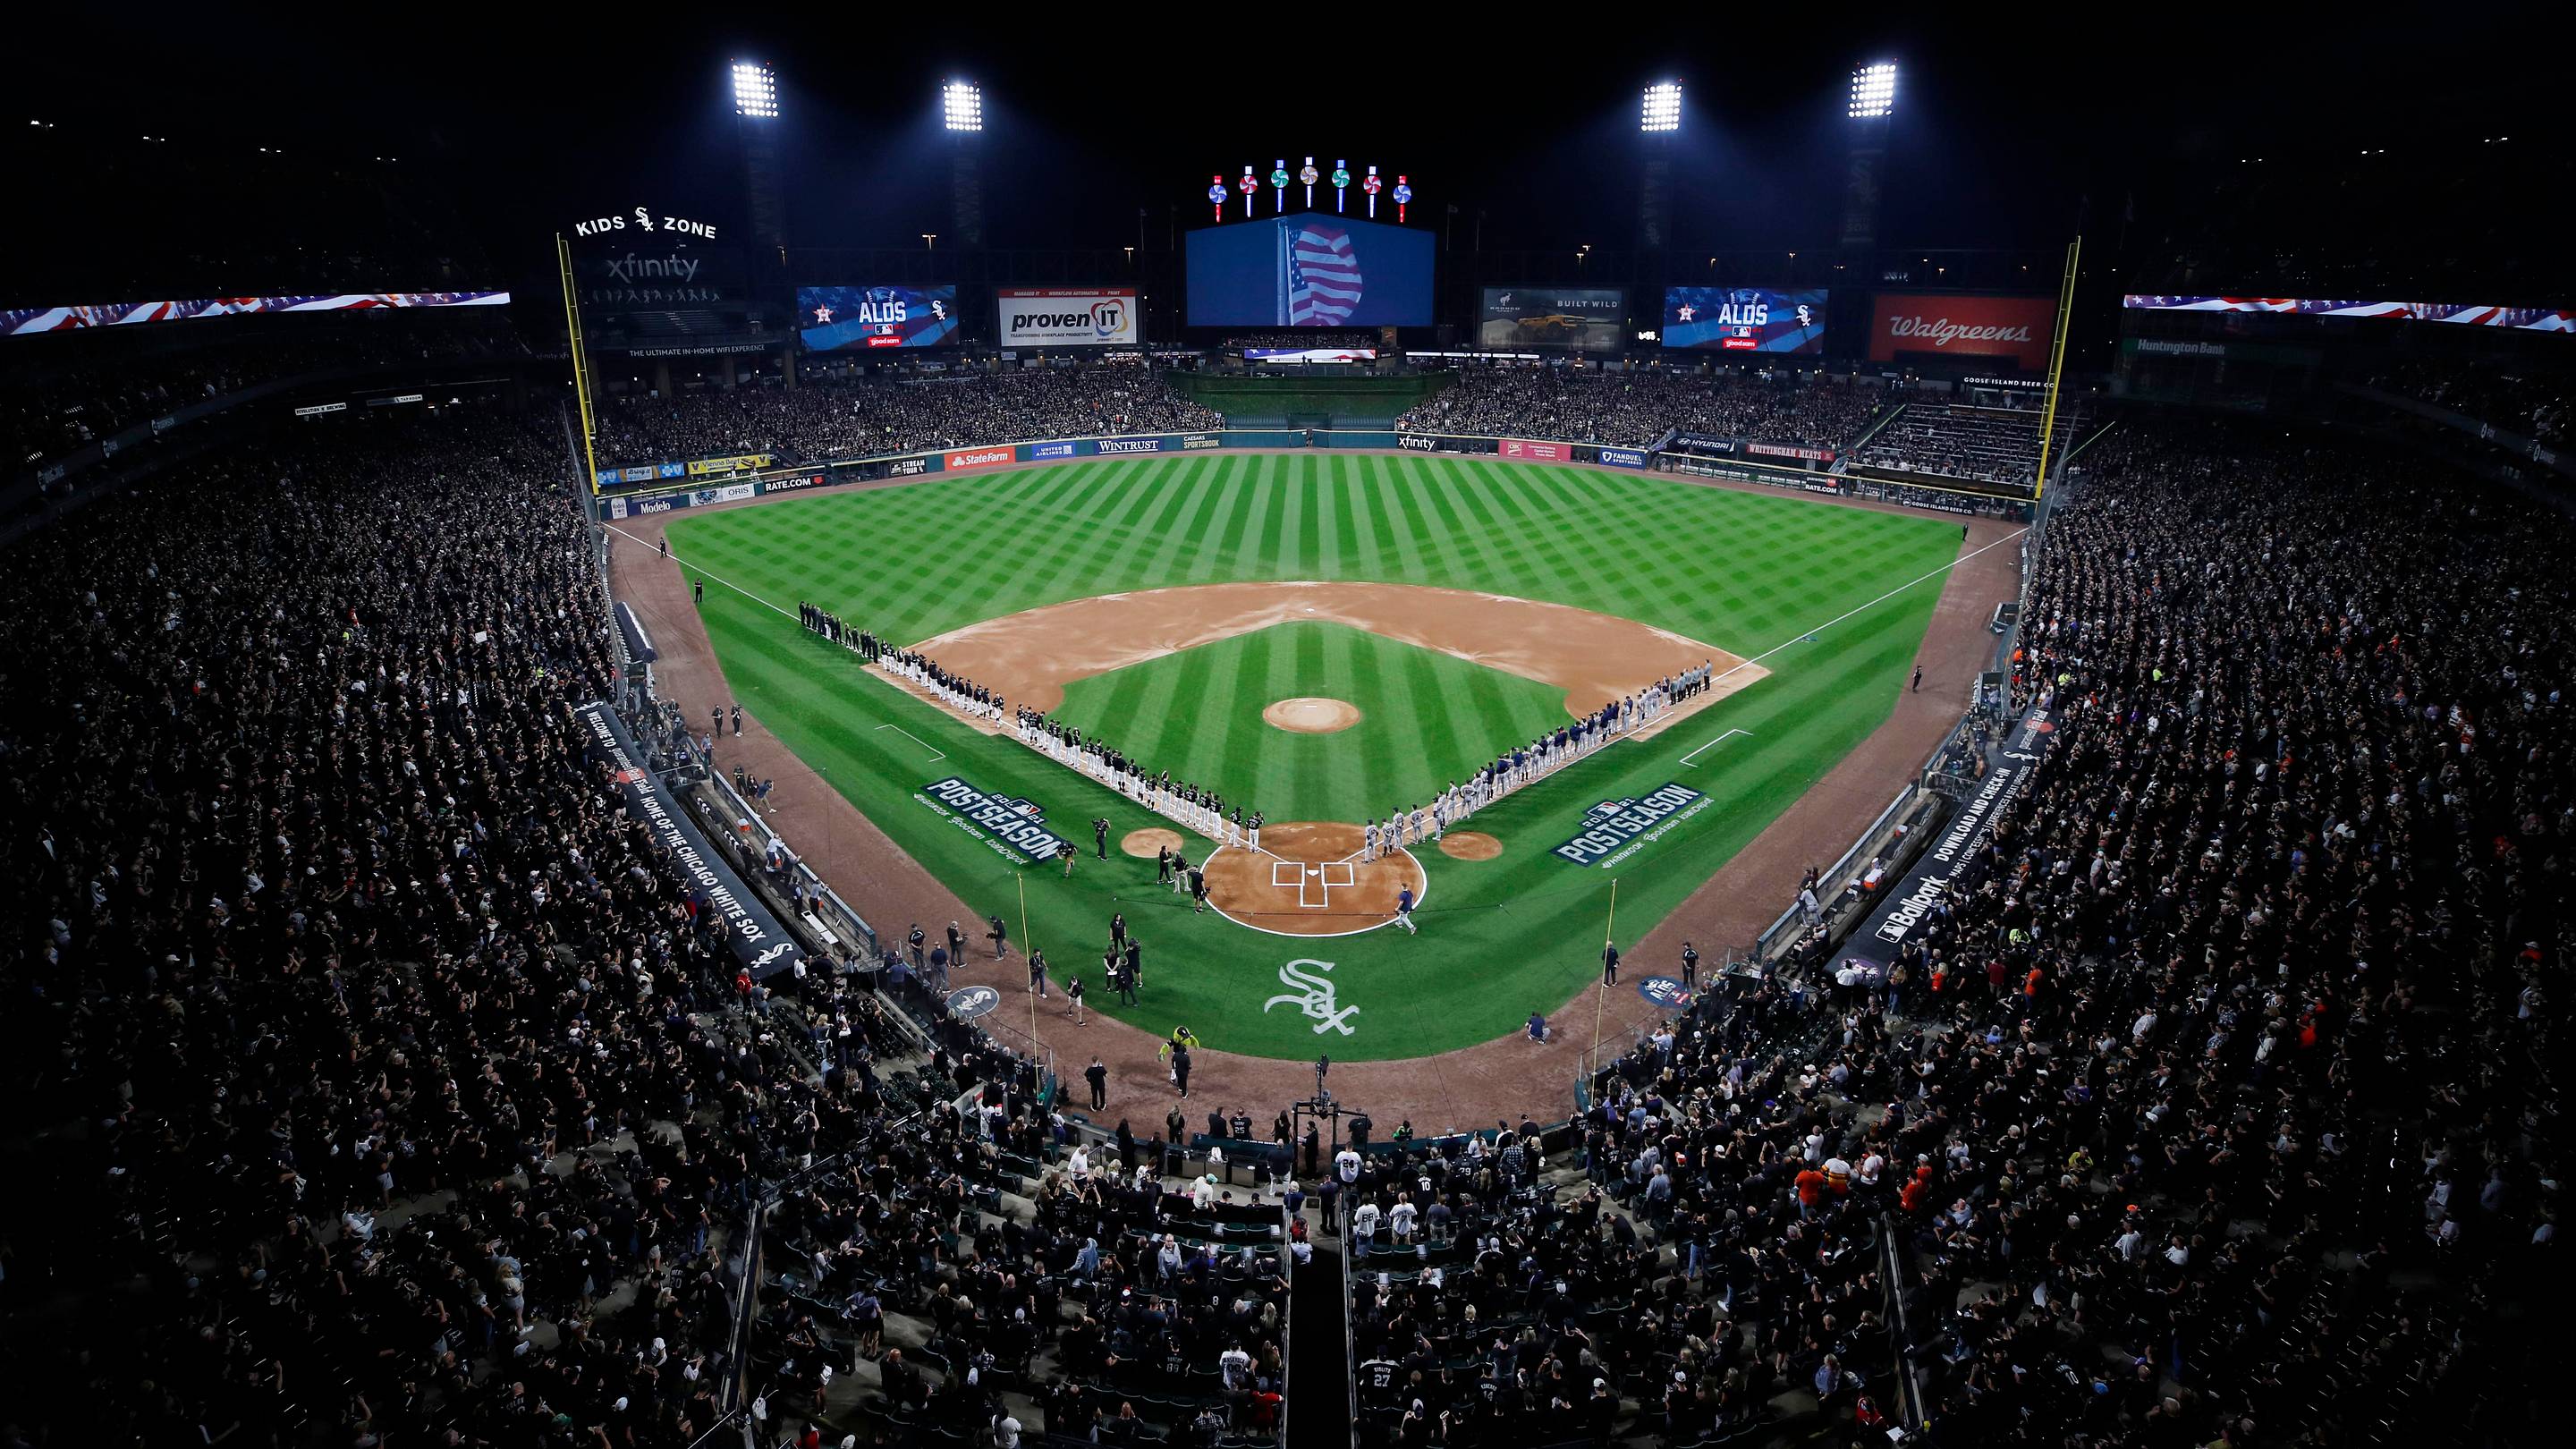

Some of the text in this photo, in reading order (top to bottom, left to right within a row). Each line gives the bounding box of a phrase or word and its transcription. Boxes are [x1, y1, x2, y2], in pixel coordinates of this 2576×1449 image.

[575, 216, 625, 236] KIDS
[664, 216, 716, 239] ZONE
[607, 252, 699, 284] xfinity
[1557, 300, 1589, 308] BUILT
[859, 301, 907, 323] ALDS
[1718, 303, 1768, 325] ALDS
[1011, 309, 1118, 332] proven IT
[1889, 316, 2031, 346] Walgreens
[646, 348, 681, 356] ULTIMATE
[682, 347, 715, 355] IN-HOME
[731, 344, 766, 352] EXPERIENCE
[2138, 339, 2225, 355] Huntington Bank
[1098, 440, 1158, 452] WINTRUST
[1183, 439, 1219, 449] SPORTSBOOK
[1398, 436, 1436, 452] xfinity
[1691, 439, 1729, 451] HYUNDAI
[1613, 453, 1642, 462] FANDUEL
[1750, 444, 1822, 460] WHITTINGHAM MEATS
[902, 460, 925, 469] STREAM
[902, 467, 917, 475] TOUR
[765, 477, 811, 491] RATE.COM
[1805, 485, 1837, 494] RATE.COM
[728, 487, 749, 496] ORIS
[640, 502, 671, 514] Modelo
[1911, 502, 1929, 510] GOOSE
[1929, 503, 1950, 513] ISLAND
[1950, 505, 1963, 513] BEER
[991, 793, 1007, 803] 20
[1618, 798, 1636, 808] 21
[1679, 797, 1716, 821] loanDepot
[927, 778, 1061, 860] POSTSEASON
[1028, 814, 1045, 824] 21
[1556, 784, 1699, 864] POSTSEASON
[1581, 818, 1600, 828] 20
[587, 710, 613, 740] WELCOME
[602, 737, 617, 748] TO
[640, 795, 668, 820] HOME
[656, 818, 673, 834] OF
[665, 827, 687, 848] THE
[676, 843, 718, 886] CHICAGO
[708, 882, 747, 919] WHITE
[736, 917, 767, 944] SOX
[1933, 814, 1979, 862] DOWNLOAD
[1970, 798, 1989, 817] AND
[985, 839, 1030, 866] loanDepot
[1948, 861, 1967, 877] MAPS
[1888, 875, 1945, 928] Ballpark
[1649, 979, 1677, 1001] ALDS
[1420, 1182, 1431, 1191] 10
[1361, 1212, 1374, 1223] 88
[1212, 1295, 1219, 1306] 8
[1373, 1374, 1391, 1387] 27
[1483, 1390, 1494, 1402] 14
